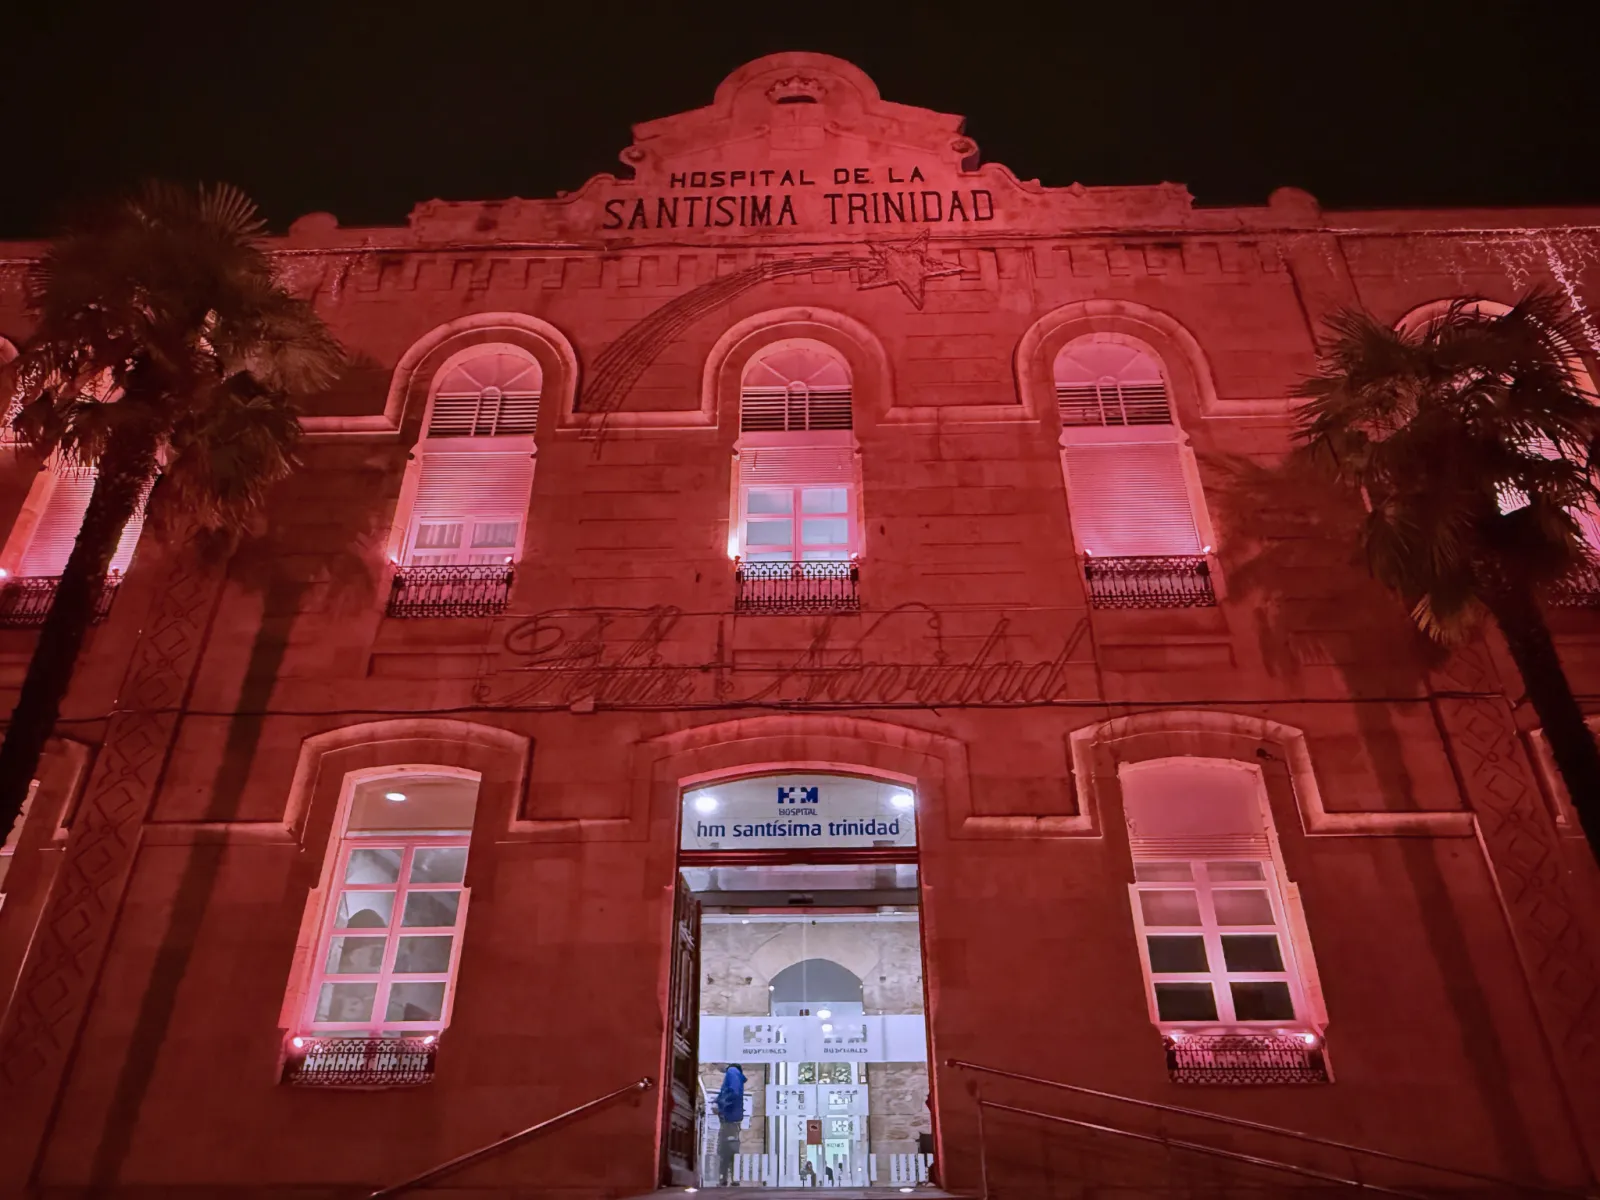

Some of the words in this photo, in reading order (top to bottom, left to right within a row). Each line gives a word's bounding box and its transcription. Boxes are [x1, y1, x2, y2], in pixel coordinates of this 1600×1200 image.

[670, 168, 816, 188] HOSPITAL
[834, 166, 870, 185] DE
[888, 165, 925, 184] LA
[602, 194, 799, 230] SANTISIMA
[825, 189, 995, 225] TRINIDAD
[778, 807, 818, 816] HOSPITAL
[696, 820, 726, 837] hm
[732, 819, 822, 837] santísima
[828, 818, 900, 836] trinidad
